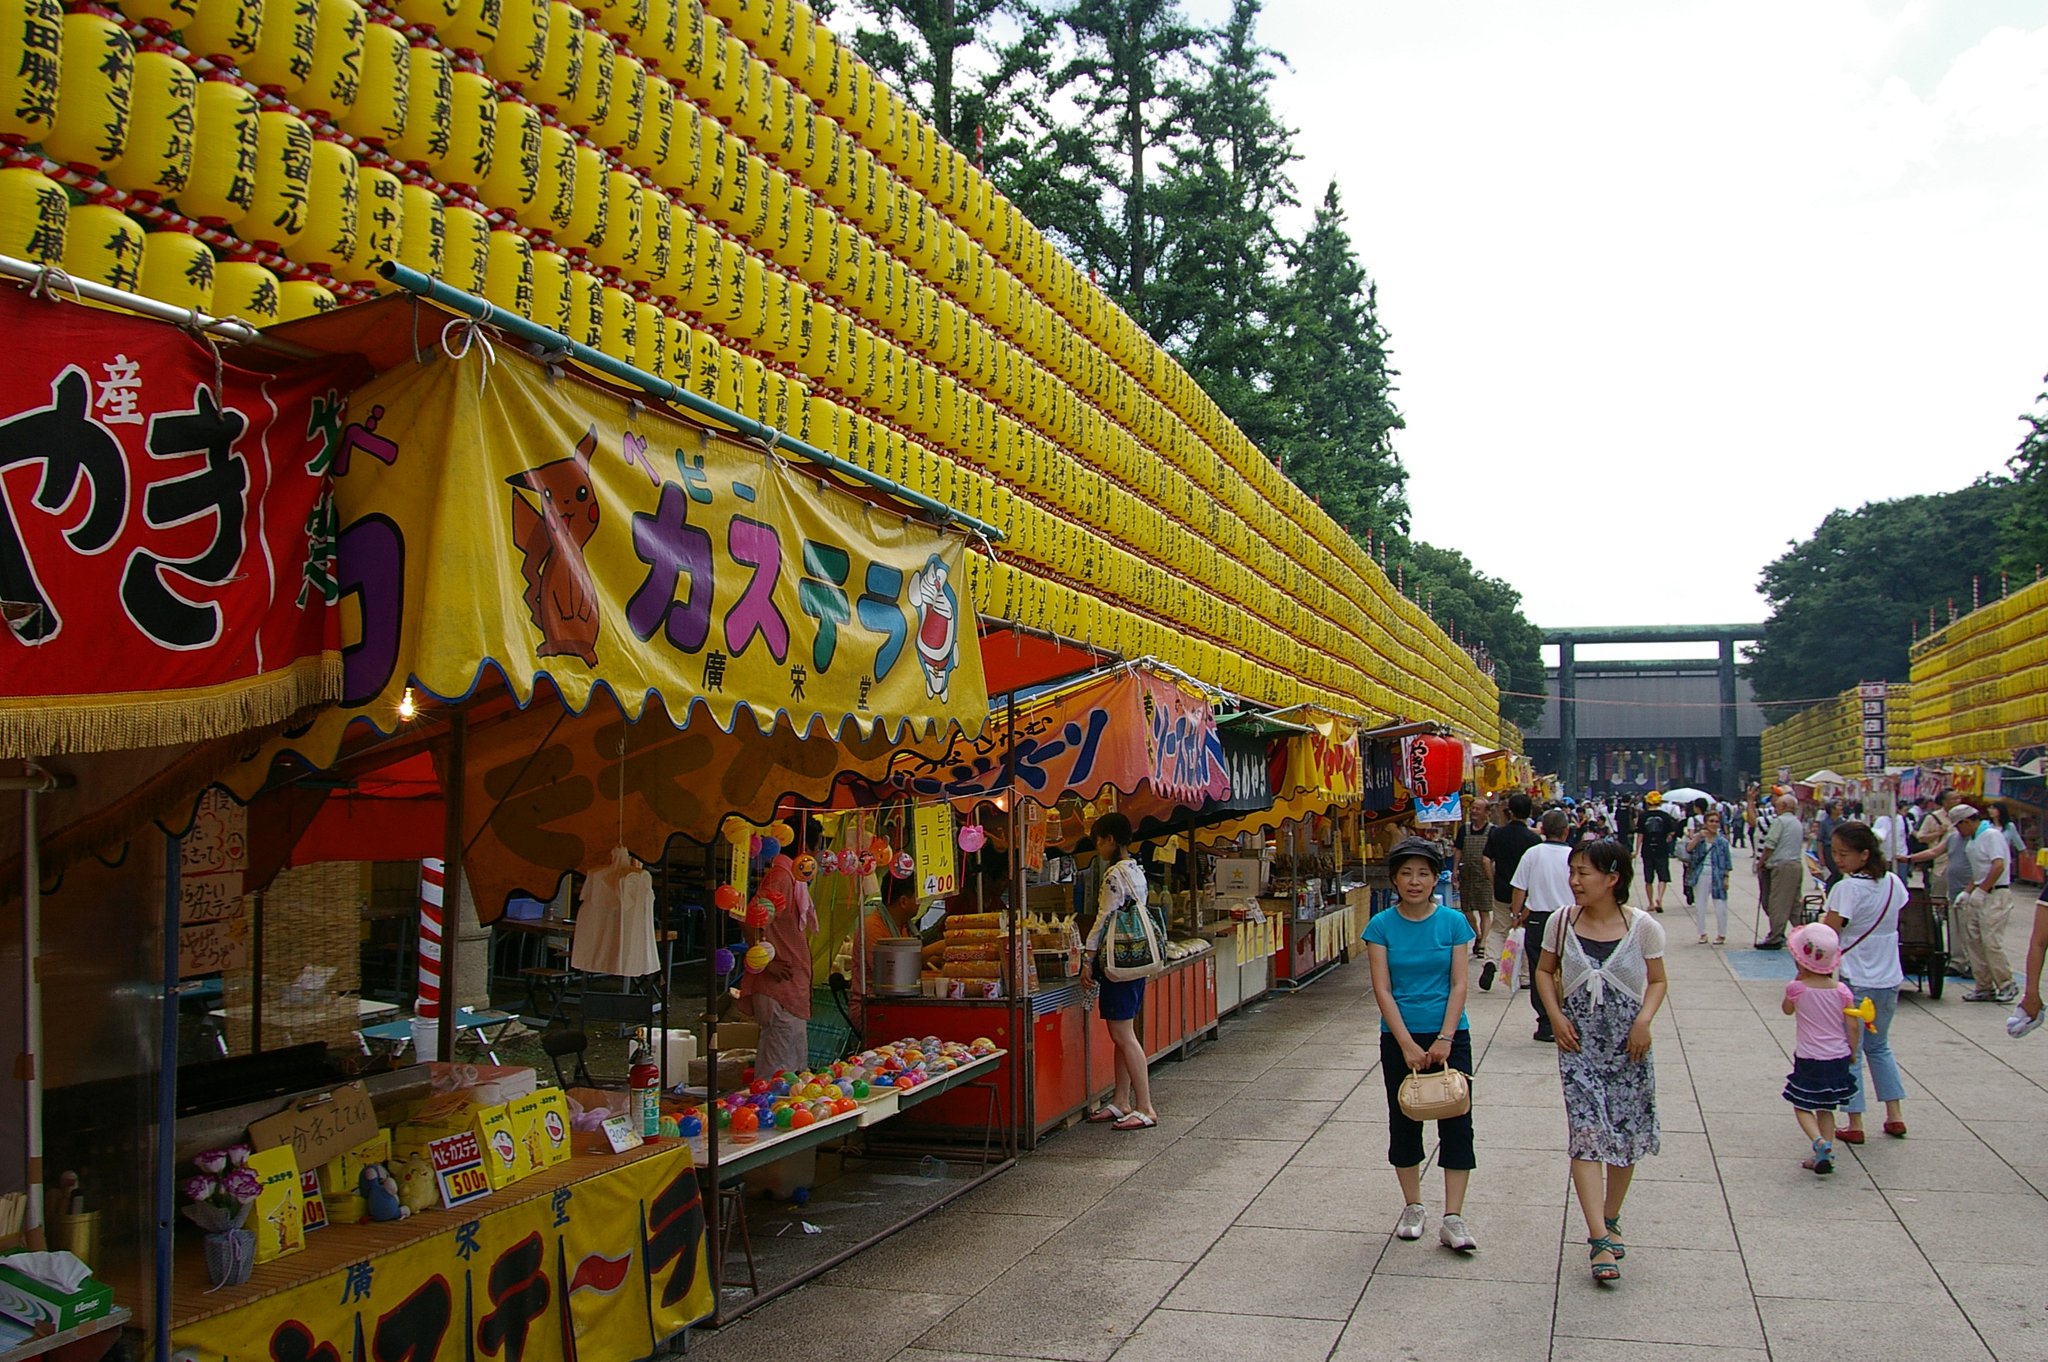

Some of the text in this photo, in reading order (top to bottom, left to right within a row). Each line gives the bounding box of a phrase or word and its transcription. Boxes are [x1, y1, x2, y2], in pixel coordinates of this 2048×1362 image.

[96, 354, 144, 425] 産
[625, 480, 909, 684] カステラ
[1410, 739, 1429, 797] やきとり
[926, 874, 954, 896] 400
